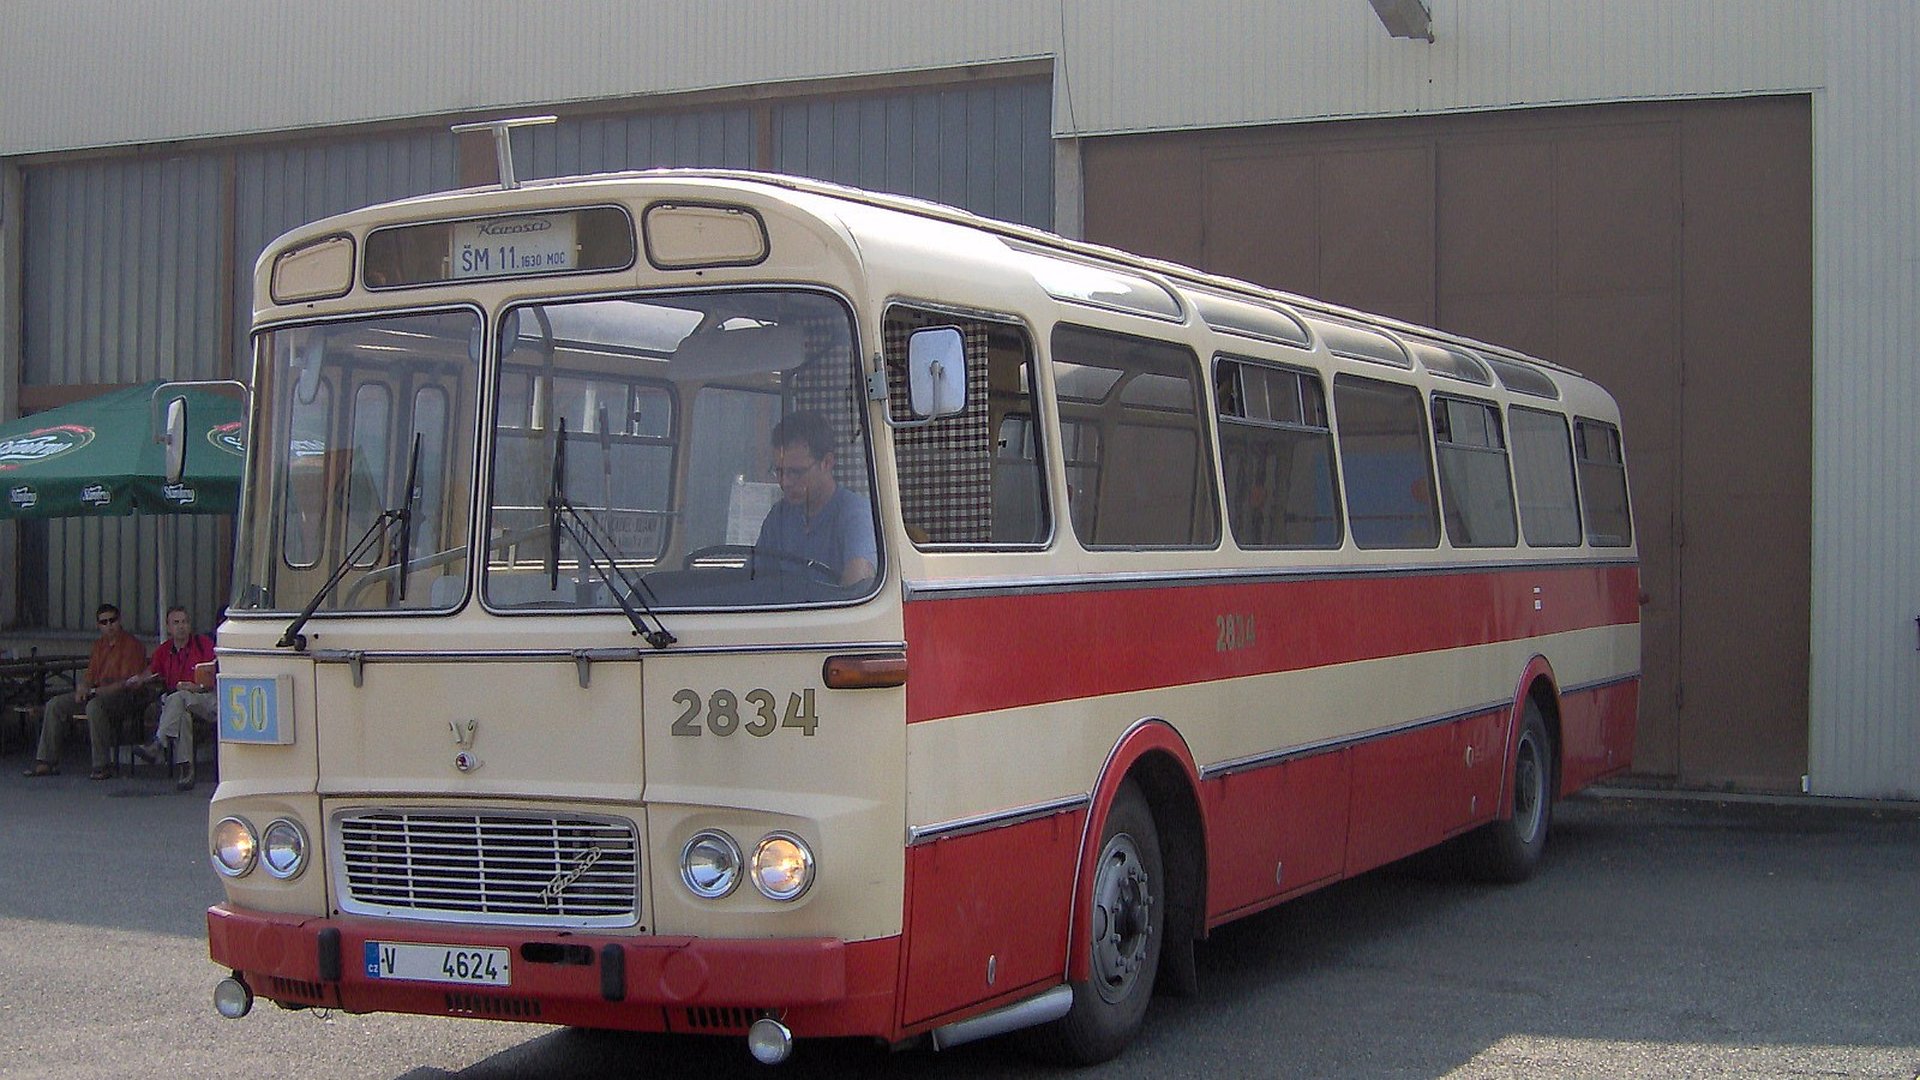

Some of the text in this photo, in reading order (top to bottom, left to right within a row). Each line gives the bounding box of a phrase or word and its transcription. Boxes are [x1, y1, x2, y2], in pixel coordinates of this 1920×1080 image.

[477, 217, 552, 238] Karosa
[462, 244, 490, 272] ŠM
[1216, 614, 1256, 652] 2834
[230, 684, 268, 733] 50
[670, 687, 820, 737] 2834
[367, 964, 379, 973] CZ
[384, 947, 498, 980] V 4624
